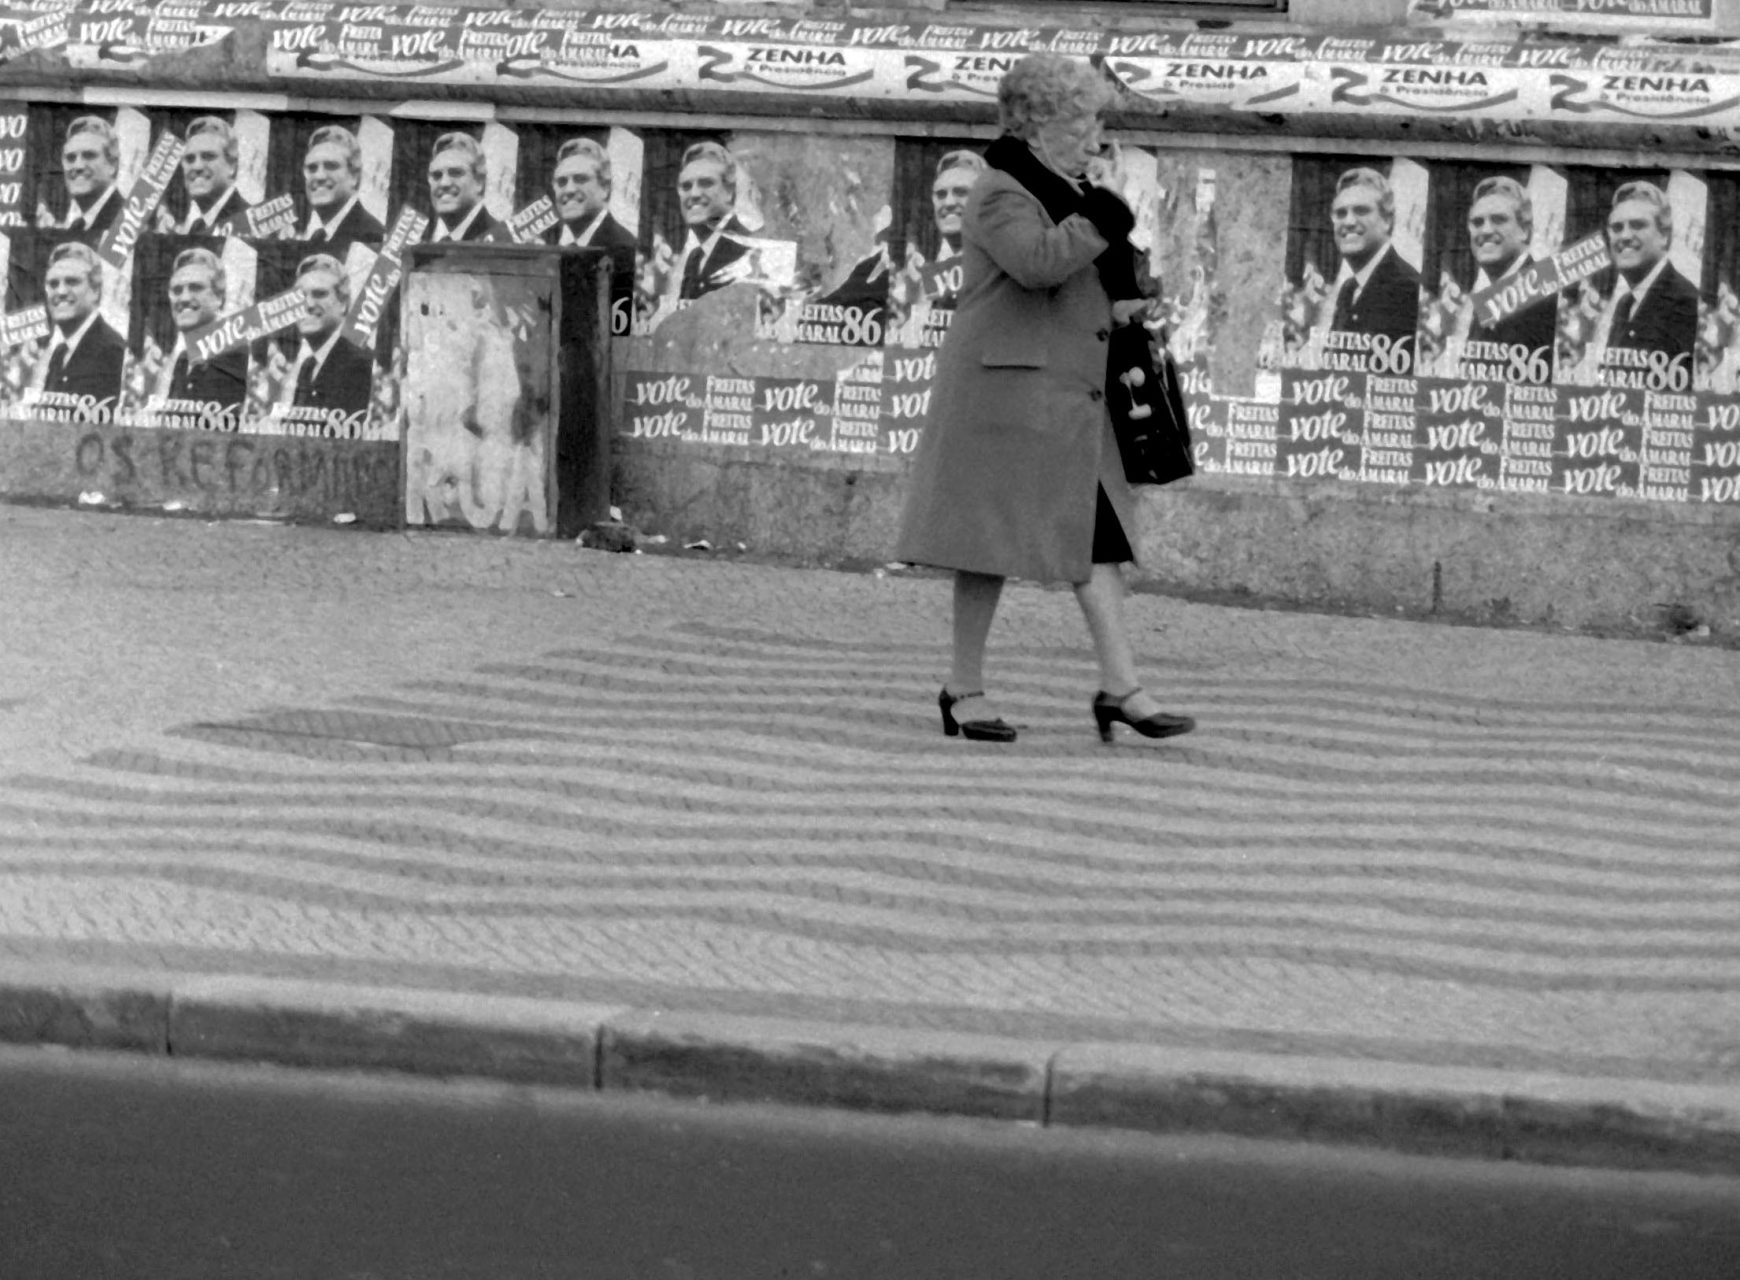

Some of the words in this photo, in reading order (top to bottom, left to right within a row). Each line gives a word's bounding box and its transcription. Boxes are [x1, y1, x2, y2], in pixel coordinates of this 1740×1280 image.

[391, 28, 446, 58] vote
[506, 30, 548, 58] ote
[748, 47, 847, 66] ZENHA
[1166, 63, 1268, 79] ZENHA
[1384, 69, 1489, 86] ZENHA
[1603, 75, 1711, 93] ZENHA
[111, 195, 149, 257] vote
[1486, 269, 1538, 320] vote
[1554, 234, 1607, 268] FREITAS
[196, 313, 248, 360] vote
[842, 305, 883, 345] 86
[893, 350, 937, 382] vot
[1369, 334, 1413, 375] 86
[1507, 344, 1550, 384] 86
[1646, 350, 1690, 391] 86
[637, 375, 690, 405] vote
[706, 375, 756, 394] FREITAS
[763, 381, 818, 411] vote
[891, 388, 931, 419] vot
[1292, 373, 1350, 405] vote
[1366, 374, 1418, 393] FREITAS
[1365, 394, 1415, 412] AMARAL
[1429, 383, 1488, 414] vote
[1506, 382, 1558, 402] FREITAS
[1227, 402, 1280, 421] FREITAS
[1503, 402, 1555, 421] AMARAL
[1569, 390, 1627, 423] vote
[633, 409, 687, 438] vote
[704, 409, 752, 431] FREITAS
[760, 417, 814, 447] vote
[1289, 411, 1347, 441] vote
[1364, 411, 1416, 430] FREITAS
[1427, 419, 1485, 451] vote
[1503, 420, 1555, 439] FREITAS
[1226, 439, 1278, 458] FREITAS
[1361, 430, 1414, 448] AMARAL
[1501, 439, 1553, 458] AMARAL
[1566, 426, 1624, 458] vote
[1287, 446, 1344, 478] vote
[1361, 446, 1413, 466] FREITAS
[1357, 466, 1410, 485] AMARAL
[1425, 455, 1482, 486] vote
[1501, 455, 1552, 475] FREITAS
[1499, 475, 1550, 493] AMARAL
[1563, 463, 1622, 495] vote
